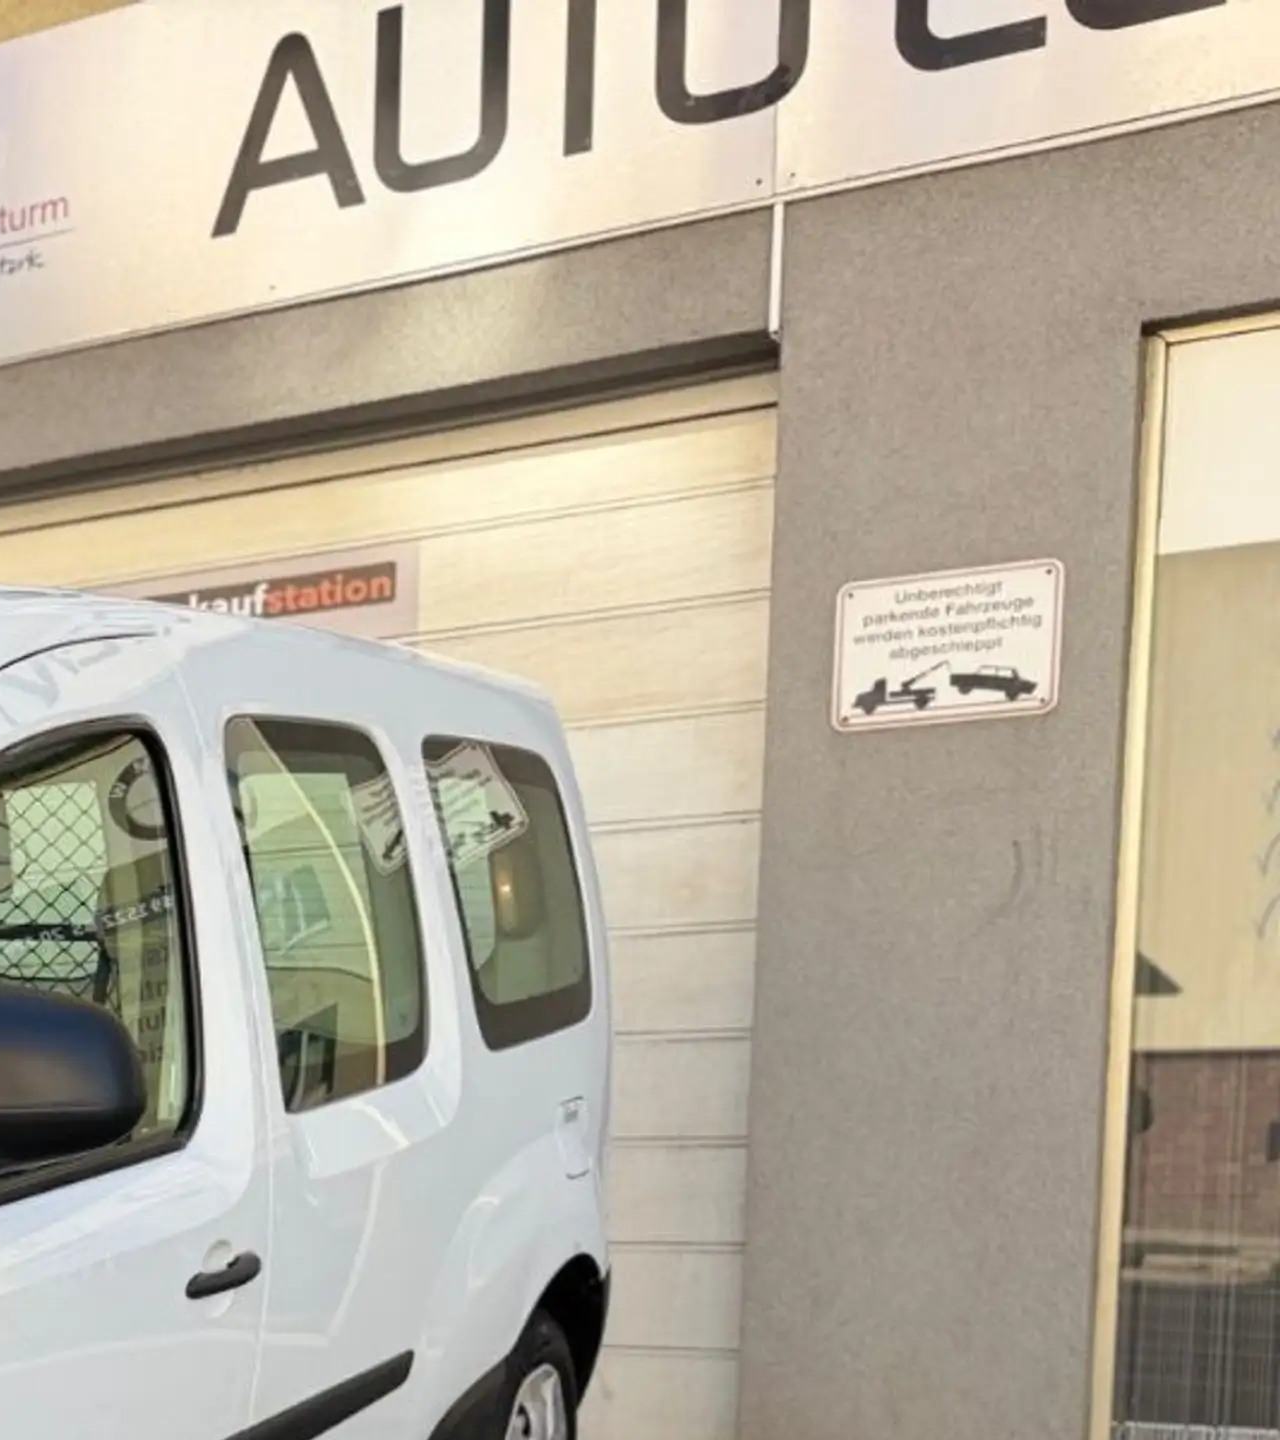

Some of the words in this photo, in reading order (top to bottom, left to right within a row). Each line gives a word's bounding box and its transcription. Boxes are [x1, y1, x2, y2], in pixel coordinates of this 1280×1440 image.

[894, 581, 1003, 604] Unberechtigt
[862, 606, 939, 627] parkende
[946, 596, 1034, 616] Fahrzeuge
[853, 626, 913, 645] werden
[918, 614, 1042, 638] kostenpflichtig
[890, 636, 1003, 660] abgeschleppt
